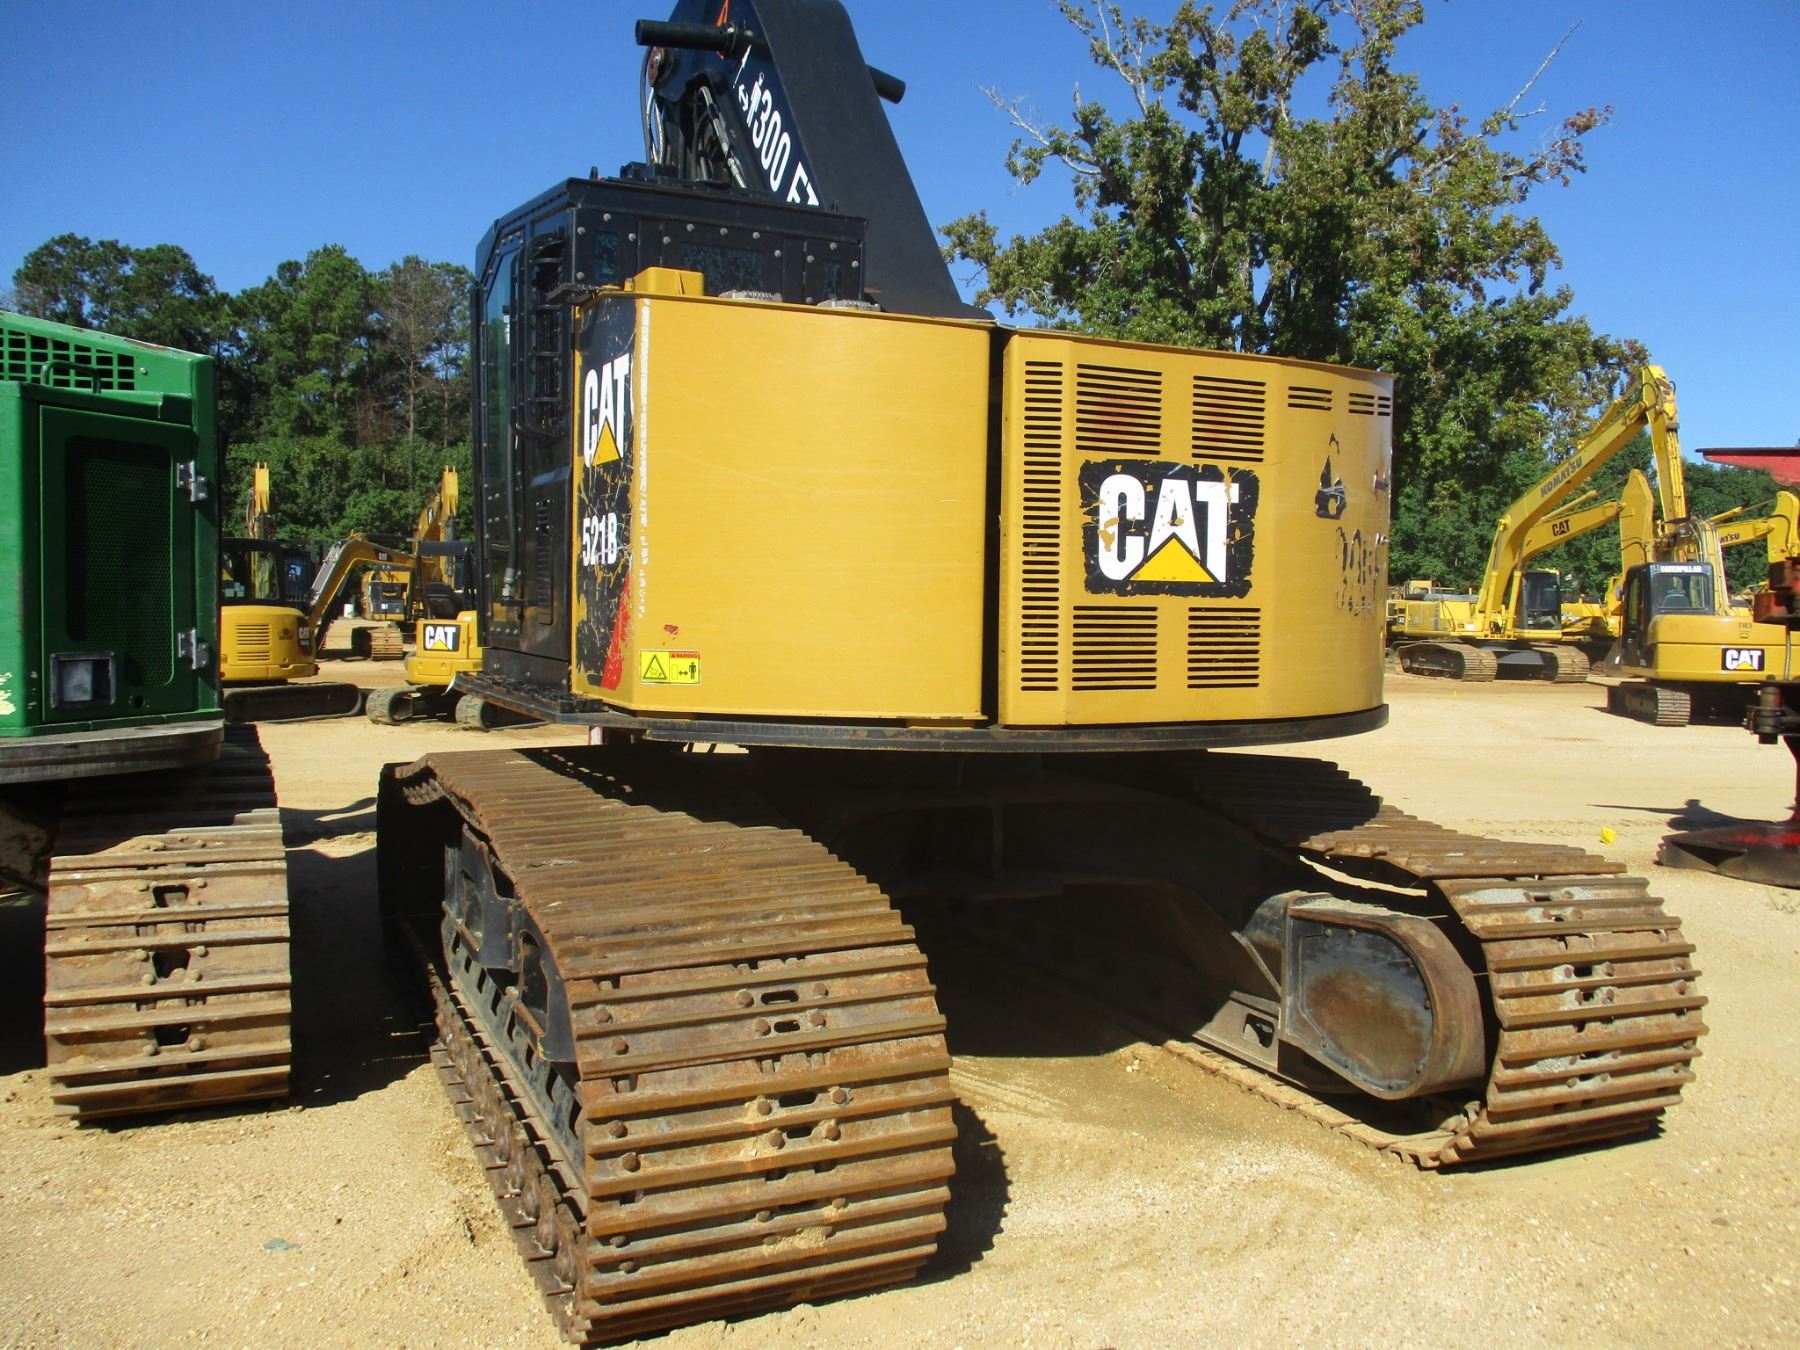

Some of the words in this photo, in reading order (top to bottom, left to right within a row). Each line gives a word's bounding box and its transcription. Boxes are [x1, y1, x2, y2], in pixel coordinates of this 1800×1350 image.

[752, 89, 791, 192] 300
[583, 352, 630, 468] CAT
[1540, 456, 1582, 497] KOMATSU
[582, 512, 617, 567] 521B
[1098, 474, 1239, 583] CAT
[1552, 519, 1570, 537] CAT
[1720, 533, 1740, 543] ATSU
[1660, 565, 1702, 573] CATERPILLAR
[425, 625, 457, 650] CAT
[1725, 649, 1762, 670] CAT
